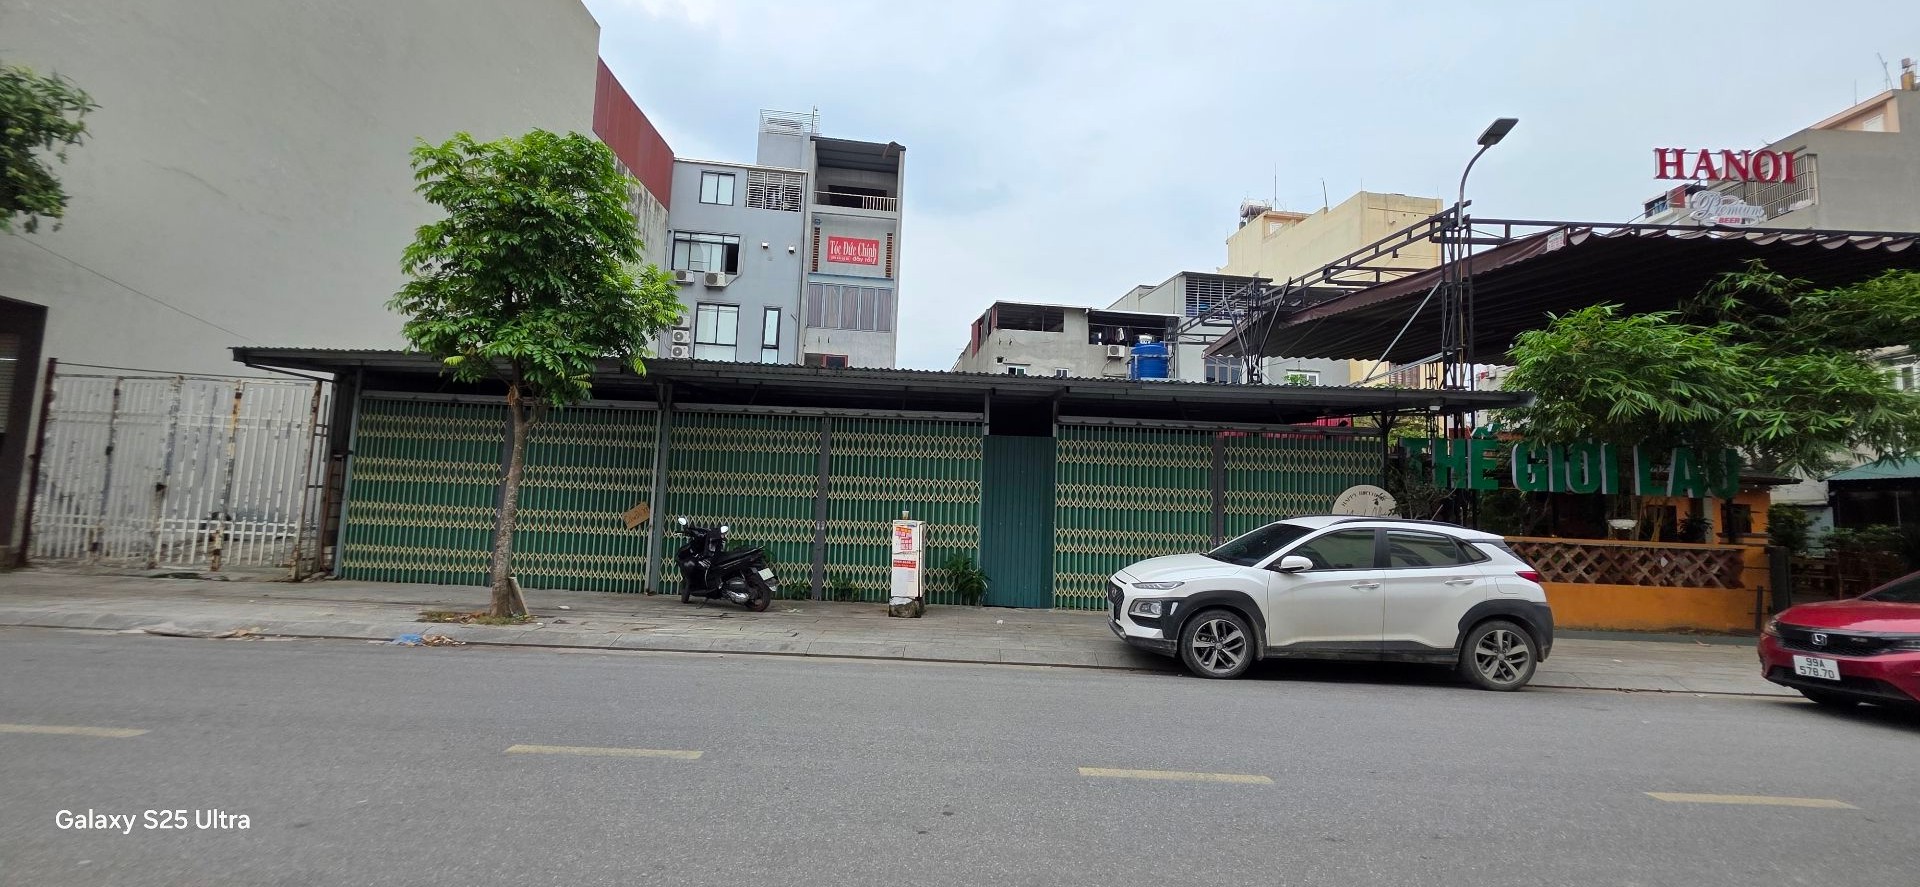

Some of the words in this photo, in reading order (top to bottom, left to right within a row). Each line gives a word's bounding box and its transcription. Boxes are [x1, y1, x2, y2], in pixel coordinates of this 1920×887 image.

[1654, 148, 1796, 183] HANOI
[1690, 191, 1764, 219] Premium
[830, 240, 841, 255] Tóc
[857, 243, 877, 258] Chính
[1805, 657, 1825, 668] 99A
